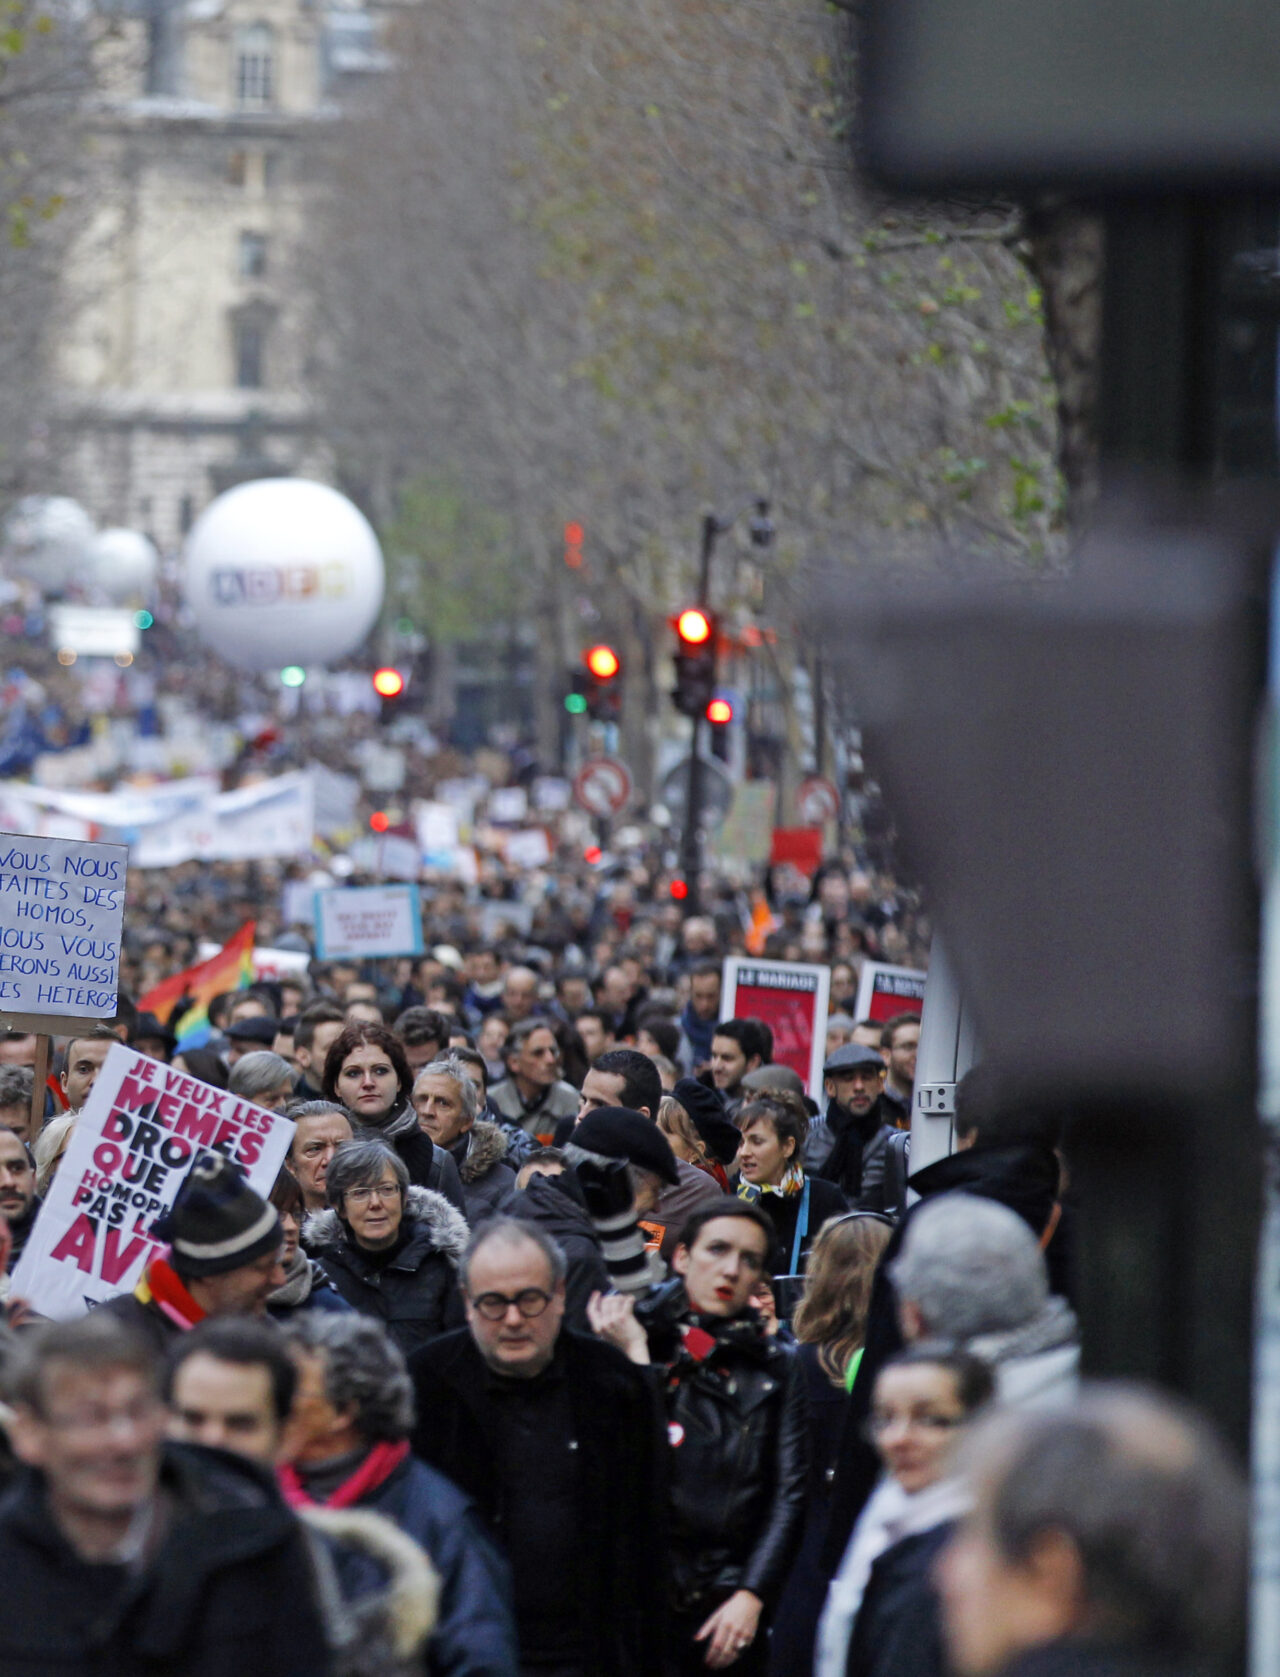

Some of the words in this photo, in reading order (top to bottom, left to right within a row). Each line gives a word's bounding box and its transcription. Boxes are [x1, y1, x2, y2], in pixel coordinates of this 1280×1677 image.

[64, 856, 120, 880] NOUS
[0, 873, 69, 900] FAITES
[83, 886, 118, 910] DES
[17, 901, 94, 932] HOMOS,
[61, 935, 116, 961] VOUS
[67, 963, 114, 984] AUSSI
[129, 1058, 157, 1083] JE
[165, 1070, 228, 1114] VEUX
[231, 1103, 274, 1134] LES
[100, 1107, 215, 1172] DRO
[93, 1142, 169, 1195] QUE
[71, 1185, 127, 1224] PAS
